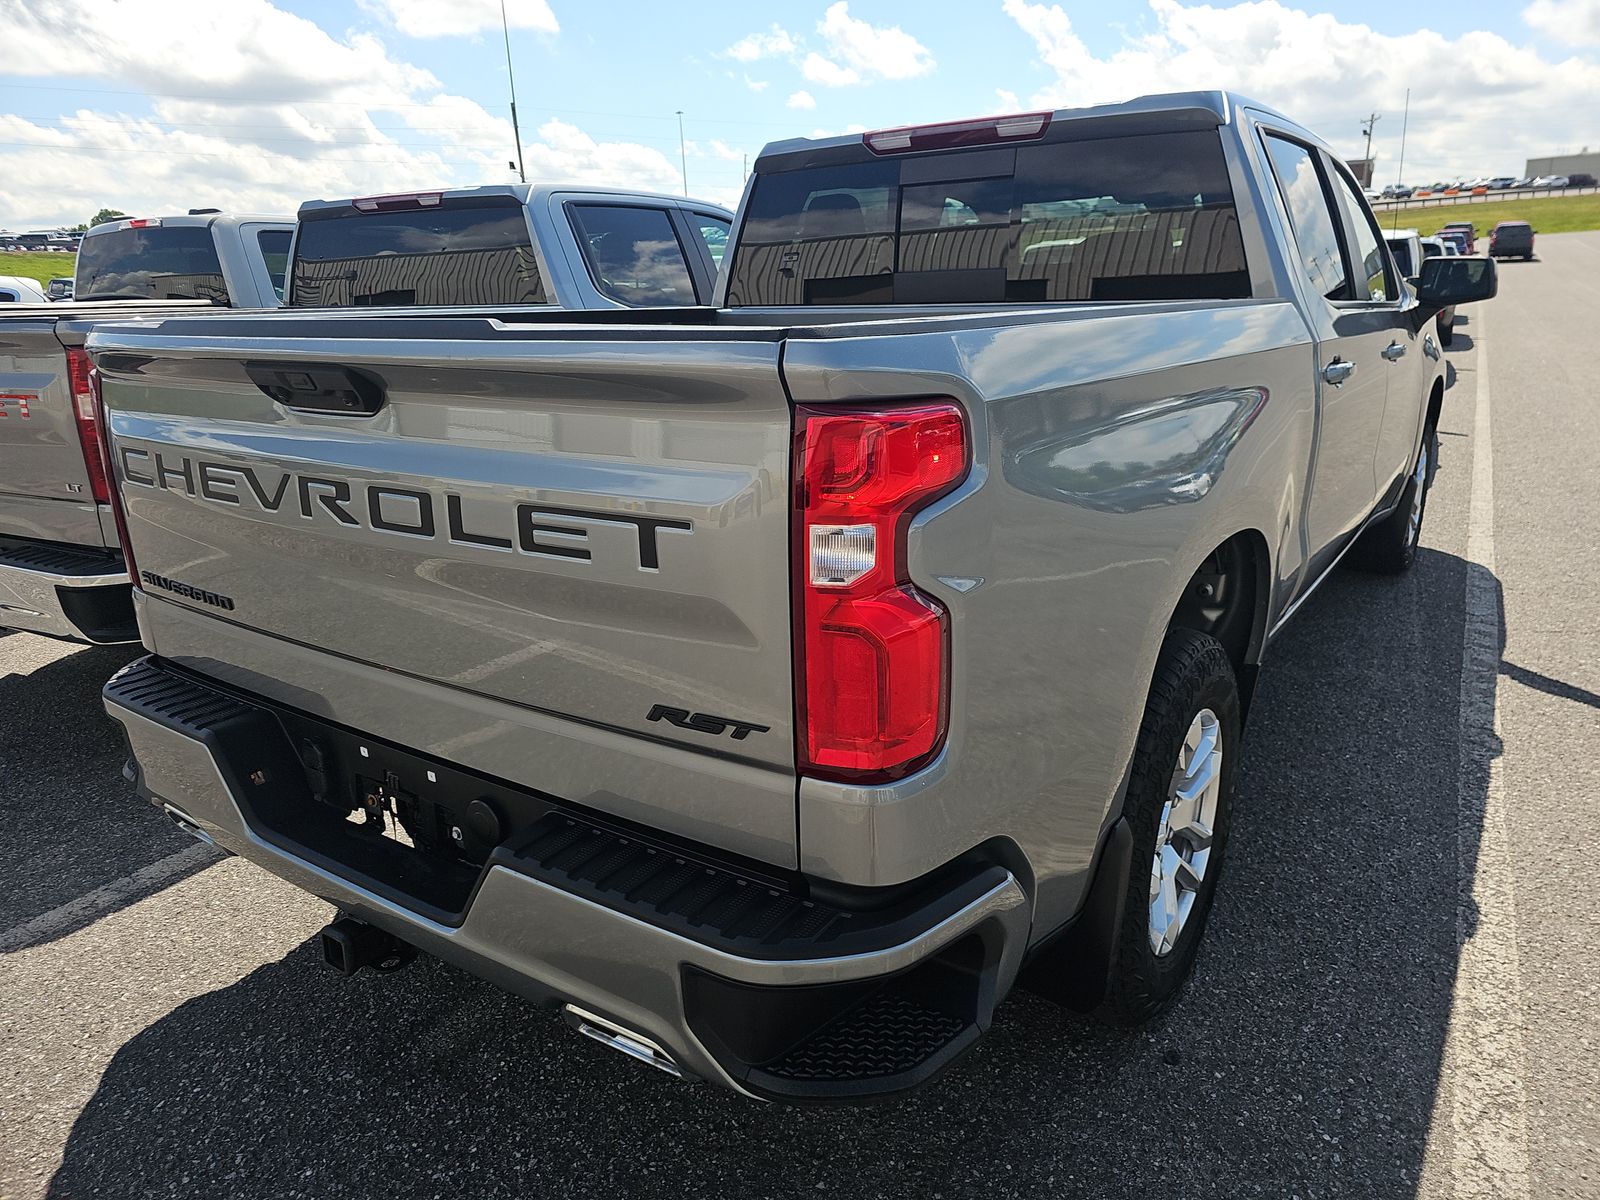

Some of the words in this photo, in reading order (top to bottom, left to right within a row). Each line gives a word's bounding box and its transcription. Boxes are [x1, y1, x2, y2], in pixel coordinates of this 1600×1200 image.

[65, 483, 83, 493] LT
[119, 447, 694, 573] CHEVROLET
[141, 570, 235, 611] SILVERADO
[646, 704, 771, 741] RST
